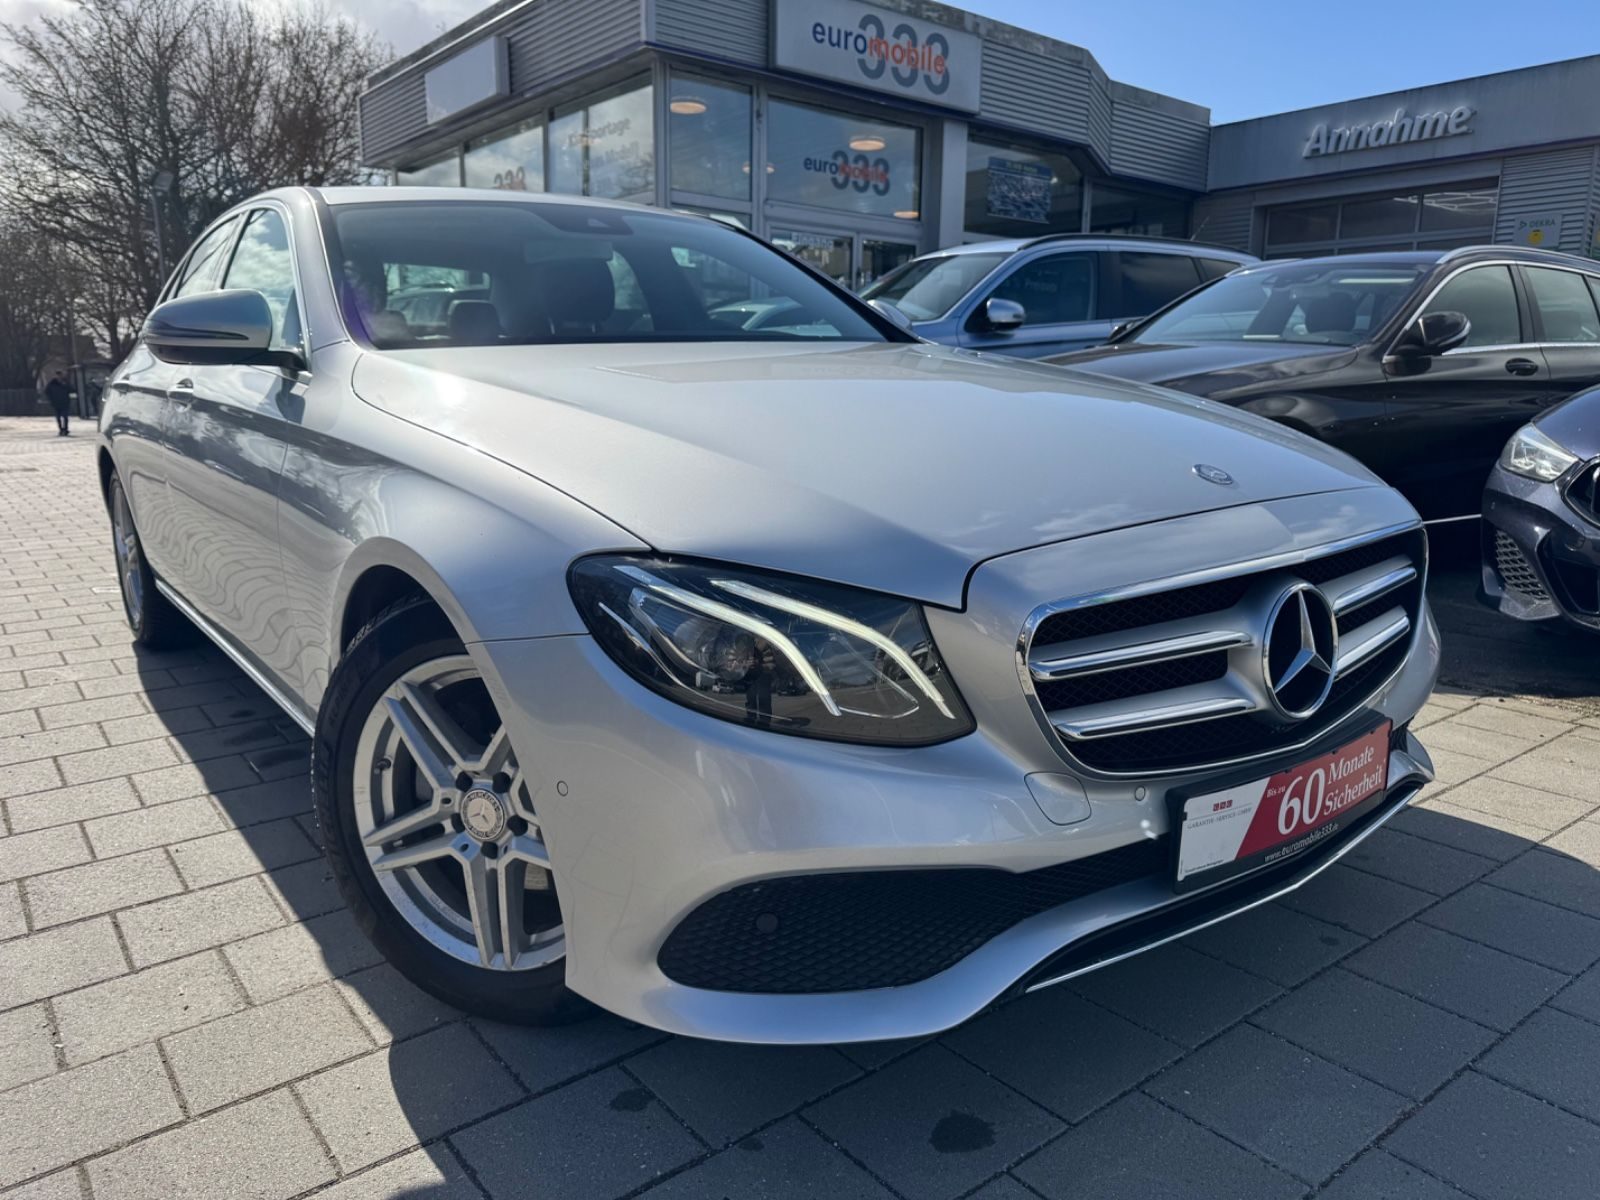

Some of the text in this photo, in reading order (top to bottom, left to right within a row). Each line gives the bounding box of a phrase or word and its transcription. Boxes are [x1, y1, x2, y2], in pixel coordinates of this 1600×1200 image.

[1303, 105, 1474, 158] Annahme
[791, 232, 834, 250] Eingang
[1528, 218, 1556, 228] DEKRA
[1328, 746, 1375, 784] Monate
[1266, 786, 1286, 797] Bis zu
[1278, 767, 1326, 835] 60
[1323, 764, 1384, 816] Sicherheit
